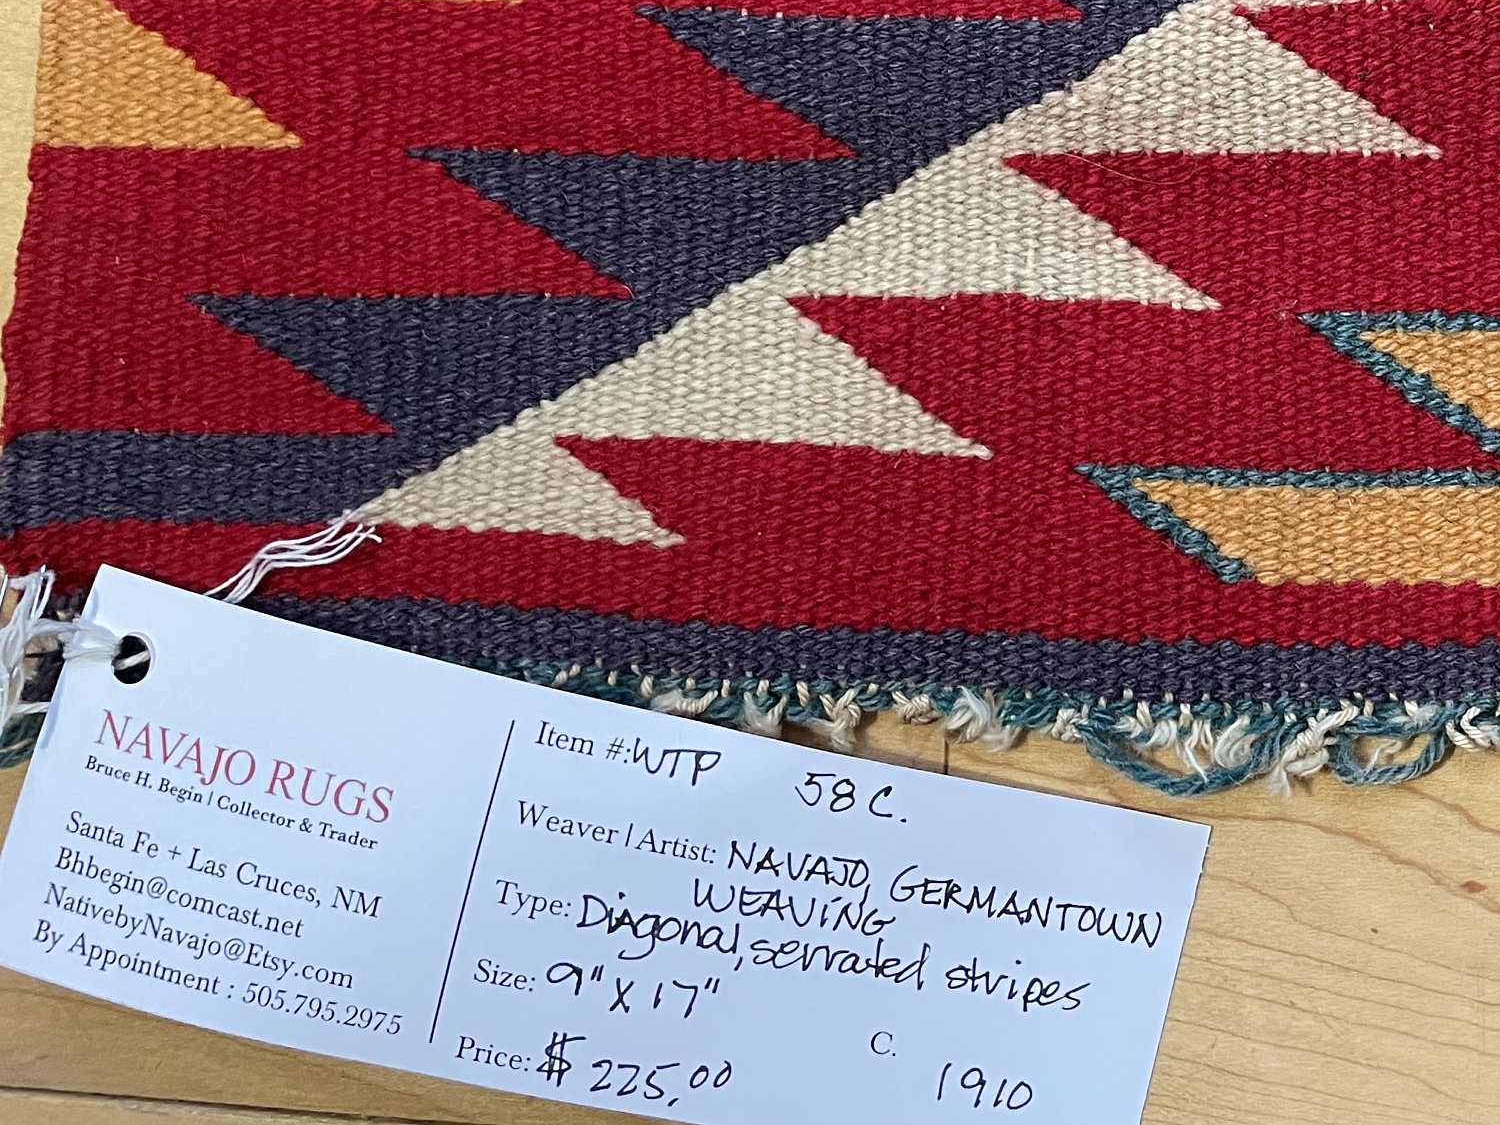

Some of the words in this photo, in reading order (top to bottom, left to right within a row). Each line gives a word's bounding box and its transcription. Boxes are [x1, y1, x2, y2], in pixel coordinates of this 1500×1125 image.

[94, 709, 256, 787] NAVAJO
[265, 759, 396, 823] RUGS
[535, 720, 595, 756] Item
[85, 754, 131, 783] Bruce
[134, 770, 155, 789] H.
[157, 778, 203, 805] Begin
[217, 795, 295, 828] Collector
[299, 817, 312, 833] &
[319, 822, 378, 851] Trader
[55, 846, 304, 939] Bhbegin@comcast.net
[66, 811, 124, 849] Santa
[131, 831, 159, 859] Fe
[168, 845, 181, 861] +
[187, 847, 228, 879] Las
[236, 862, 322, 908] Cruces,
[331, 886, 382, 917] NM
[496, 880, 572, 919] Type:
[44, 883, 354, 989] NativebyNavajo@Etsy.com
[890, 865, 1162, 948] GERMANTOWN
[33, 919, 64, 952] By
[67, 932, 220, 995] Appointment
[242, 983, 403, 1035] 505.795.2975
[473, 959, 535, 992] Size:
[750, 938, 931, 991] serrated
[946, 958, 1092, 1012] stripes
[456, 1036, 532, 1073] Price:
[870, 1031, 896, 1057] C.
[937, 1062, 1033, 1110] 1910
